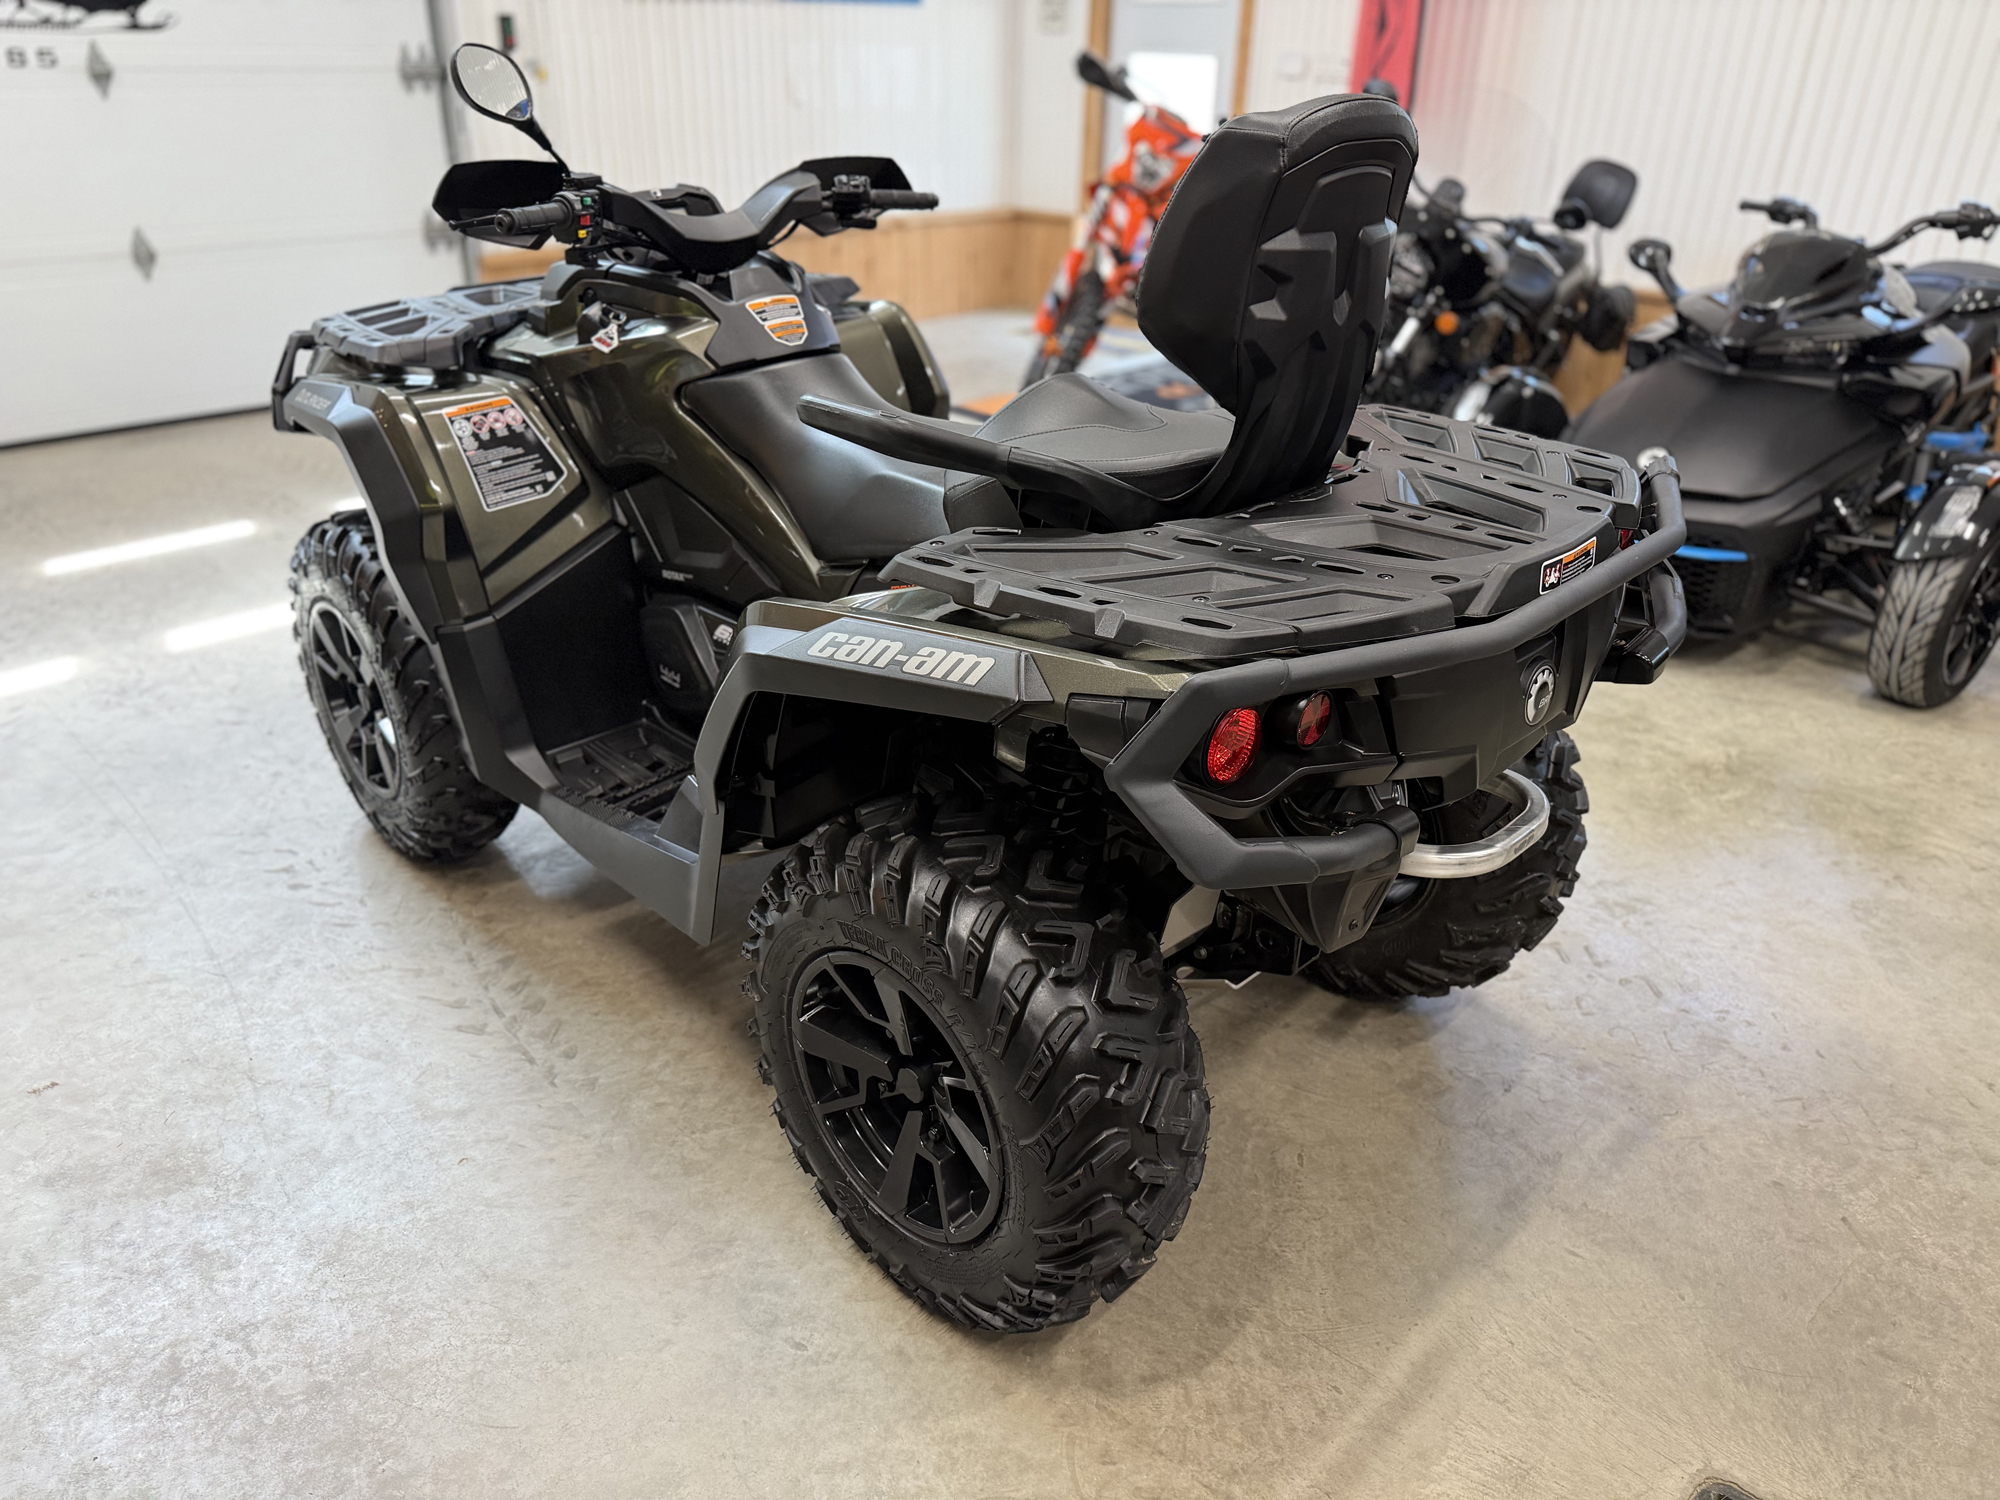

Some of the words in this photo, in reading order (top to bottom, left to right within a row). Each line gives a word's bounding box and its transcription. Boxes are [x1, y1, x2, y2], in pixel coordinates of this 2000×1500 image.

[808, 632, 995, 686] can-am
[836, 920, 889, 960] TERRA
[891, 947, 945, 1009] CROSS
